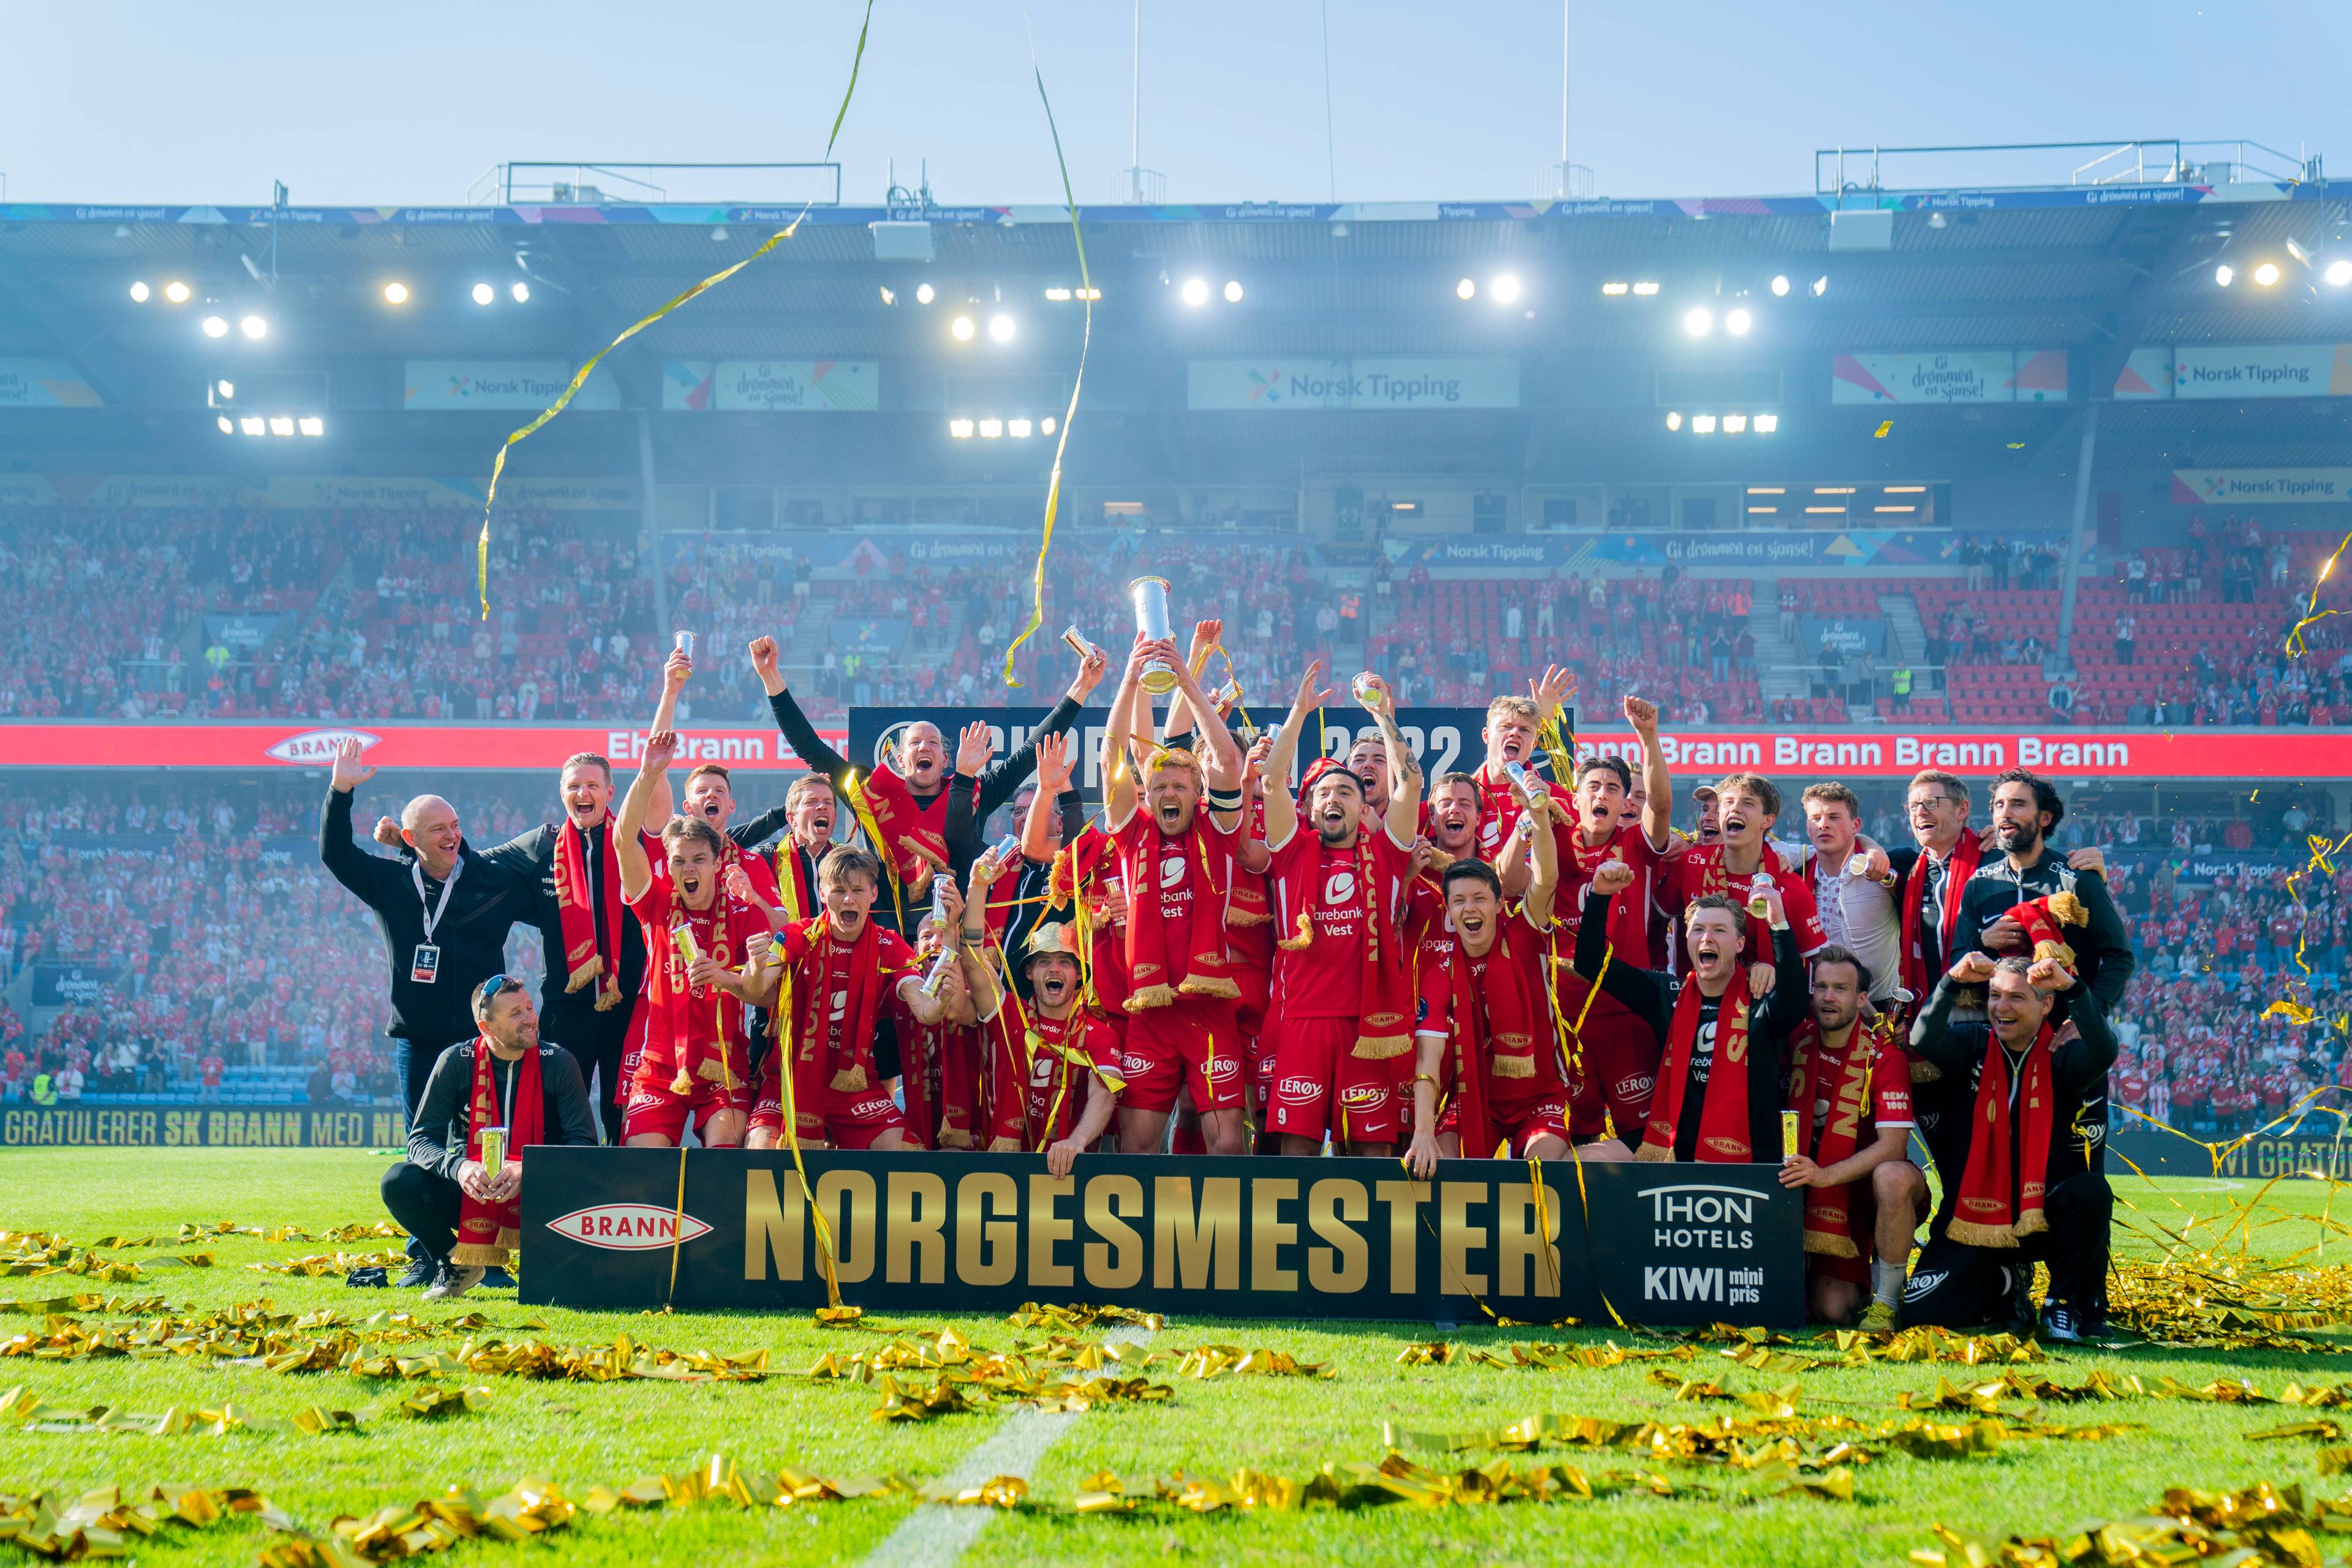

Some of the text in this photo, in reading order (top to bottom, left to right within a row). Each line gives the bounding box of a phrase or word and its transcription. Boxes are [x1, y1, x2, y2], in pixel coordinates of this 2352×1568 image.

[1932, 195, 1995, 208] Norsk Tipping
[264, 211, 289, 221] Nosk
[1912, 364, 1973, 389] drømmen
[2193, 364, 2310, 383] Norsk Tipping
[475, 377, 569, 397] Norsk Tippin
[1291, 373, 1461, 402] Norsk Tipping
[1940, 378, 1985, 402] sjanse!
[2230, 478, 2334, 496] Norsk Tipping
[1446, 543, 1544, 561] Norsk Tipping
[1666, 538, 1814, 561] Gi drømmen en sjanse!
[289, 737, 354, 756] BRAN
[672, 733, 764, 760] Brann
[1576, 737, 2128, 766] ann Brann Brann Brann Brann
[1987, 865, 2005, 876] BOB
[2059, 867, 2076, 879] BOB
[1314, 907, 1364, 922] arebank
[1324, 924, 1353, 937] Vest
[1504, 1035, 1529, 1044] BRANN
[1259, 1086, 1267, 1101] 6
[1279, 1079, 1322, 1096] LERØY
[1615, 1076, 1656, 1095] LERØY
[1882, 1091, 1909, 1101] REMA
[851, 1099, 895, 1117] LERØY
[1886, 1101, 1907, 1110] 1000
[796, 1115, 820, 1126] RANN
[1278, 1107, 1286, 1125] 9
[5, 1110, 156, 1145] GRATULERER
[164, 1111, 202, 1145] SK
[208, 1112, 301, 1146] BRANN
[310, 1112, 363, 1147] MED
[1713, 1140, 1743, 1153] BRANN
[2257, 1140, 2352, 1180] GRATU
[2026, 1185, 2045, 1194] ANN
[1638, 1185, 1770, 1224] THON
[1969, 1199, 1998, 1209] BRANN
[1816, 1208, 1846, 1221] BRANN
[581, 1216, 679, 1238] BRANN
[745, 1168, 1562, 1297] NORGESMESTER
[1654, 1228, 1754, 1250] HOTELS
[1644, 1266, 1763, 1302] KIWI mini
[1729, 1284, 1761, 1306] pris
